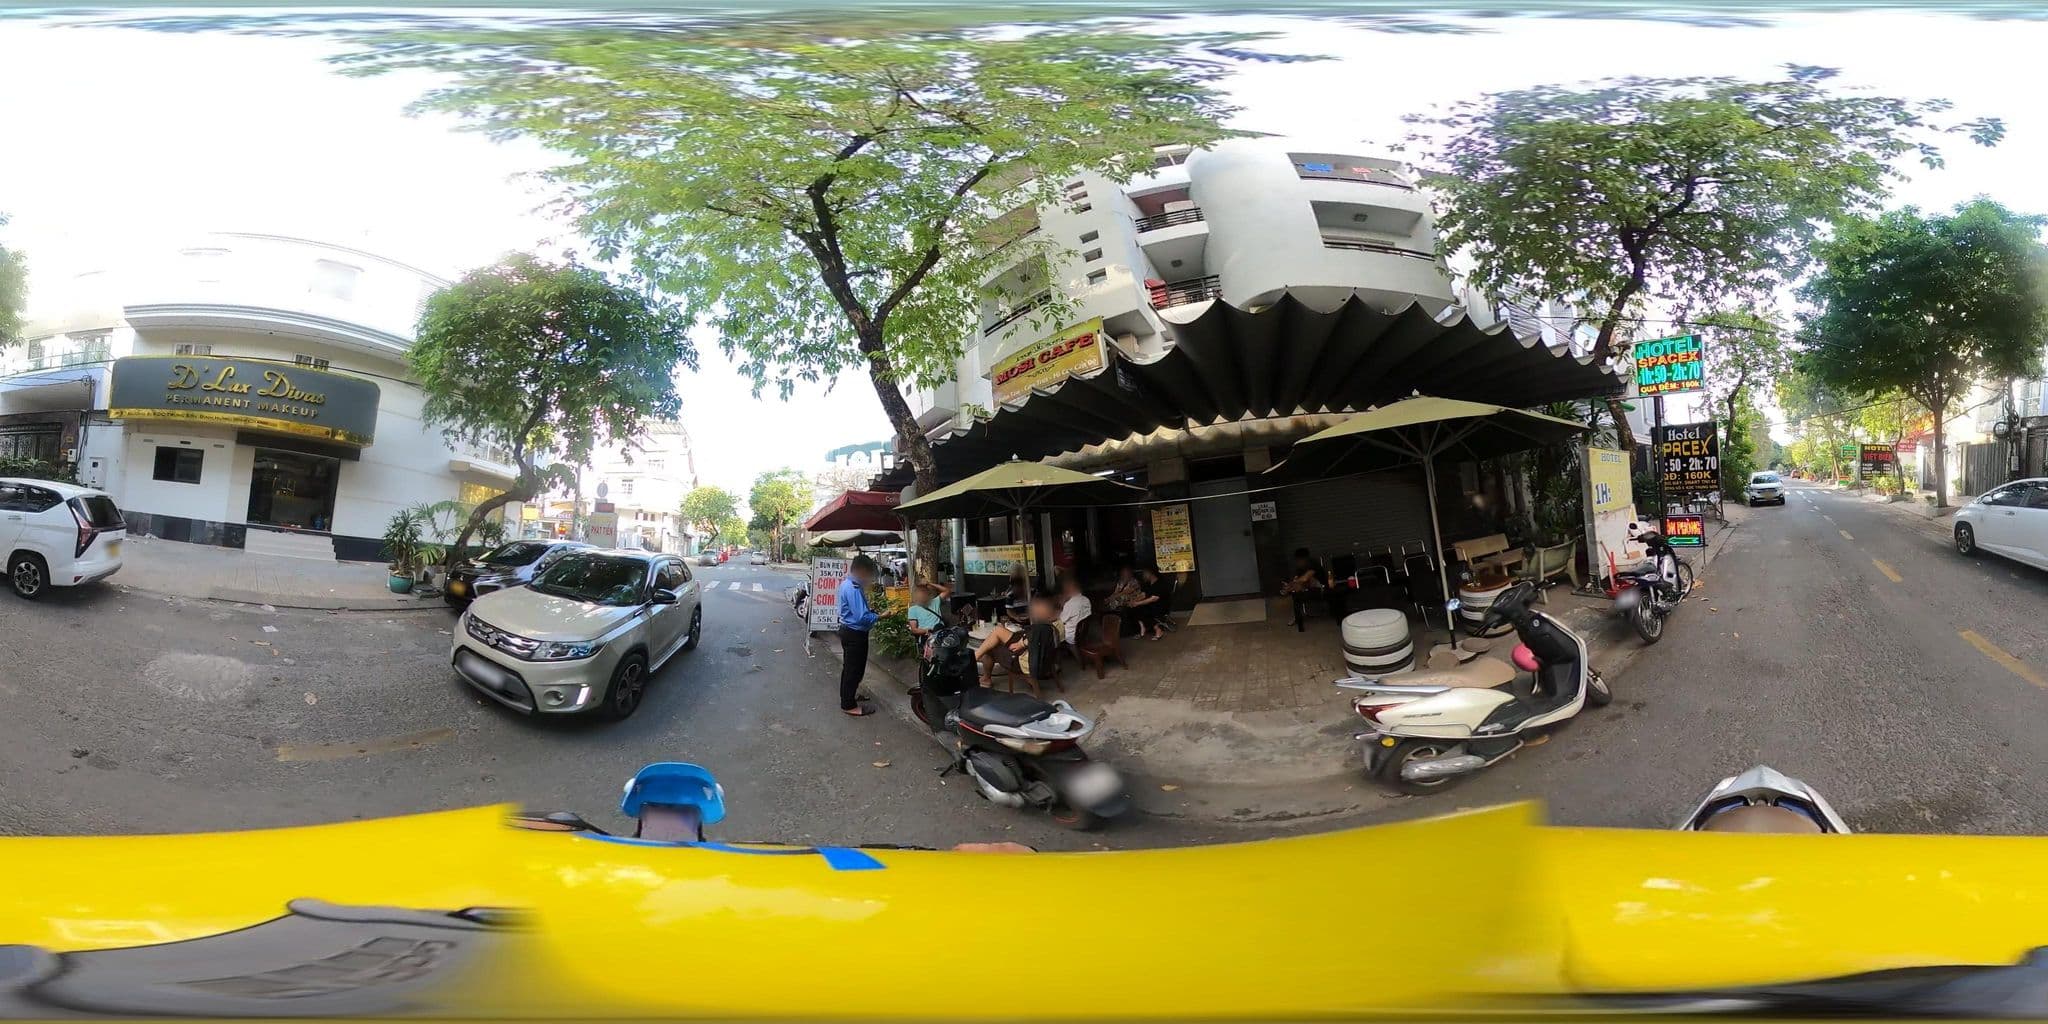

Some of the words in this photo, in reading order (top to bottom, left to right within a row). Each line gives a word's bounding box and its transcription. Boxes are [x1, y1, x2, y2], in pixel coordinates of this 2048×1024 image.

[995, 357, 1035, 385] MOSI
[1037, 332, 1094, 364] CAFE
[1636, 336, 1699, 359] HOTEL
[1638, 351, 1699, 368] SPACEX
[257, 370, 327, 405] Divas
[165, 393, 251, 409] PERMANENT
[257, 402, 319, 419] MAKEUP
[1668, 427, 1701, 440] Hotel
[1684, 471, 1711, 480] 160K
